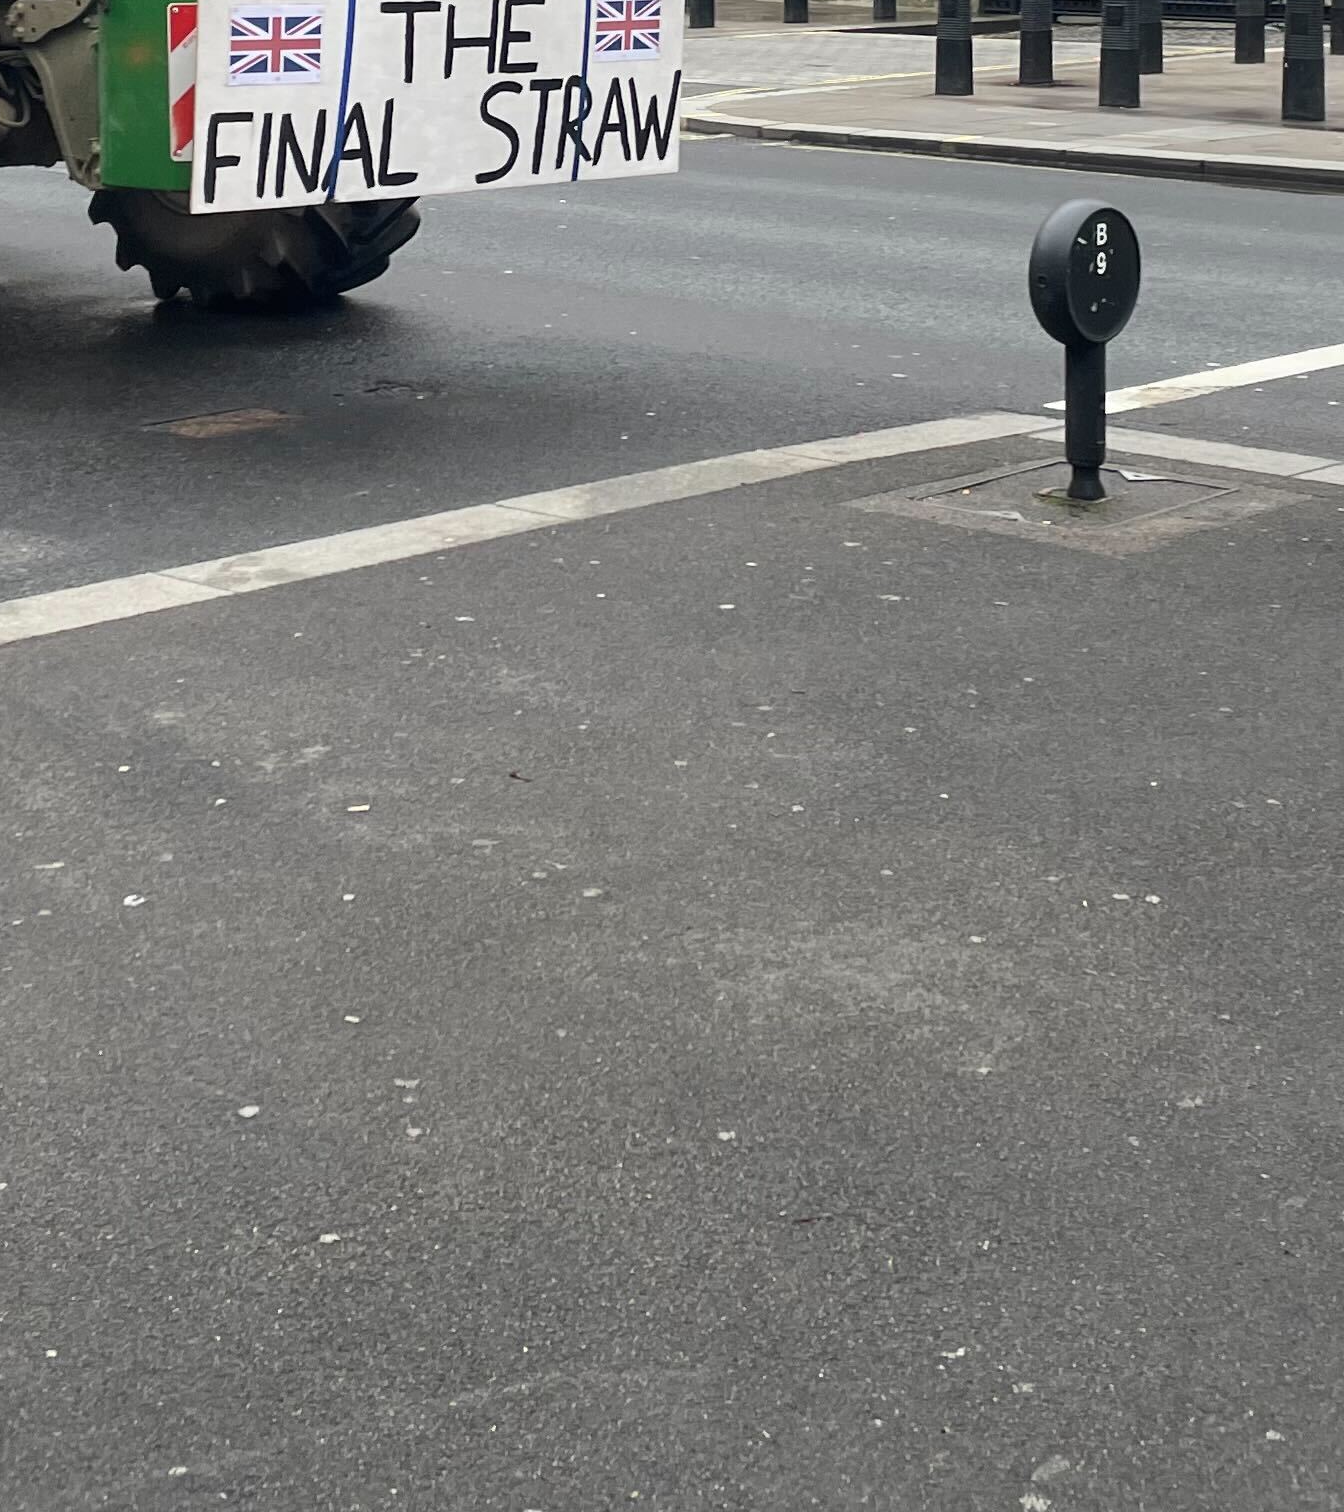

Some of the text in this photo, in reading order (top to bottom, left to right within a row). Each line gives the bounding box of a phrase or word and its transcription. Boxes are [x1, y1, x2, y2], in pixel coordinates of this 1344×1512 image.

[204, 69, 682, 205] FINAL STRAW
[1096, 222, 1107, 246] B
[1096, 251, 1107, 275] 9
